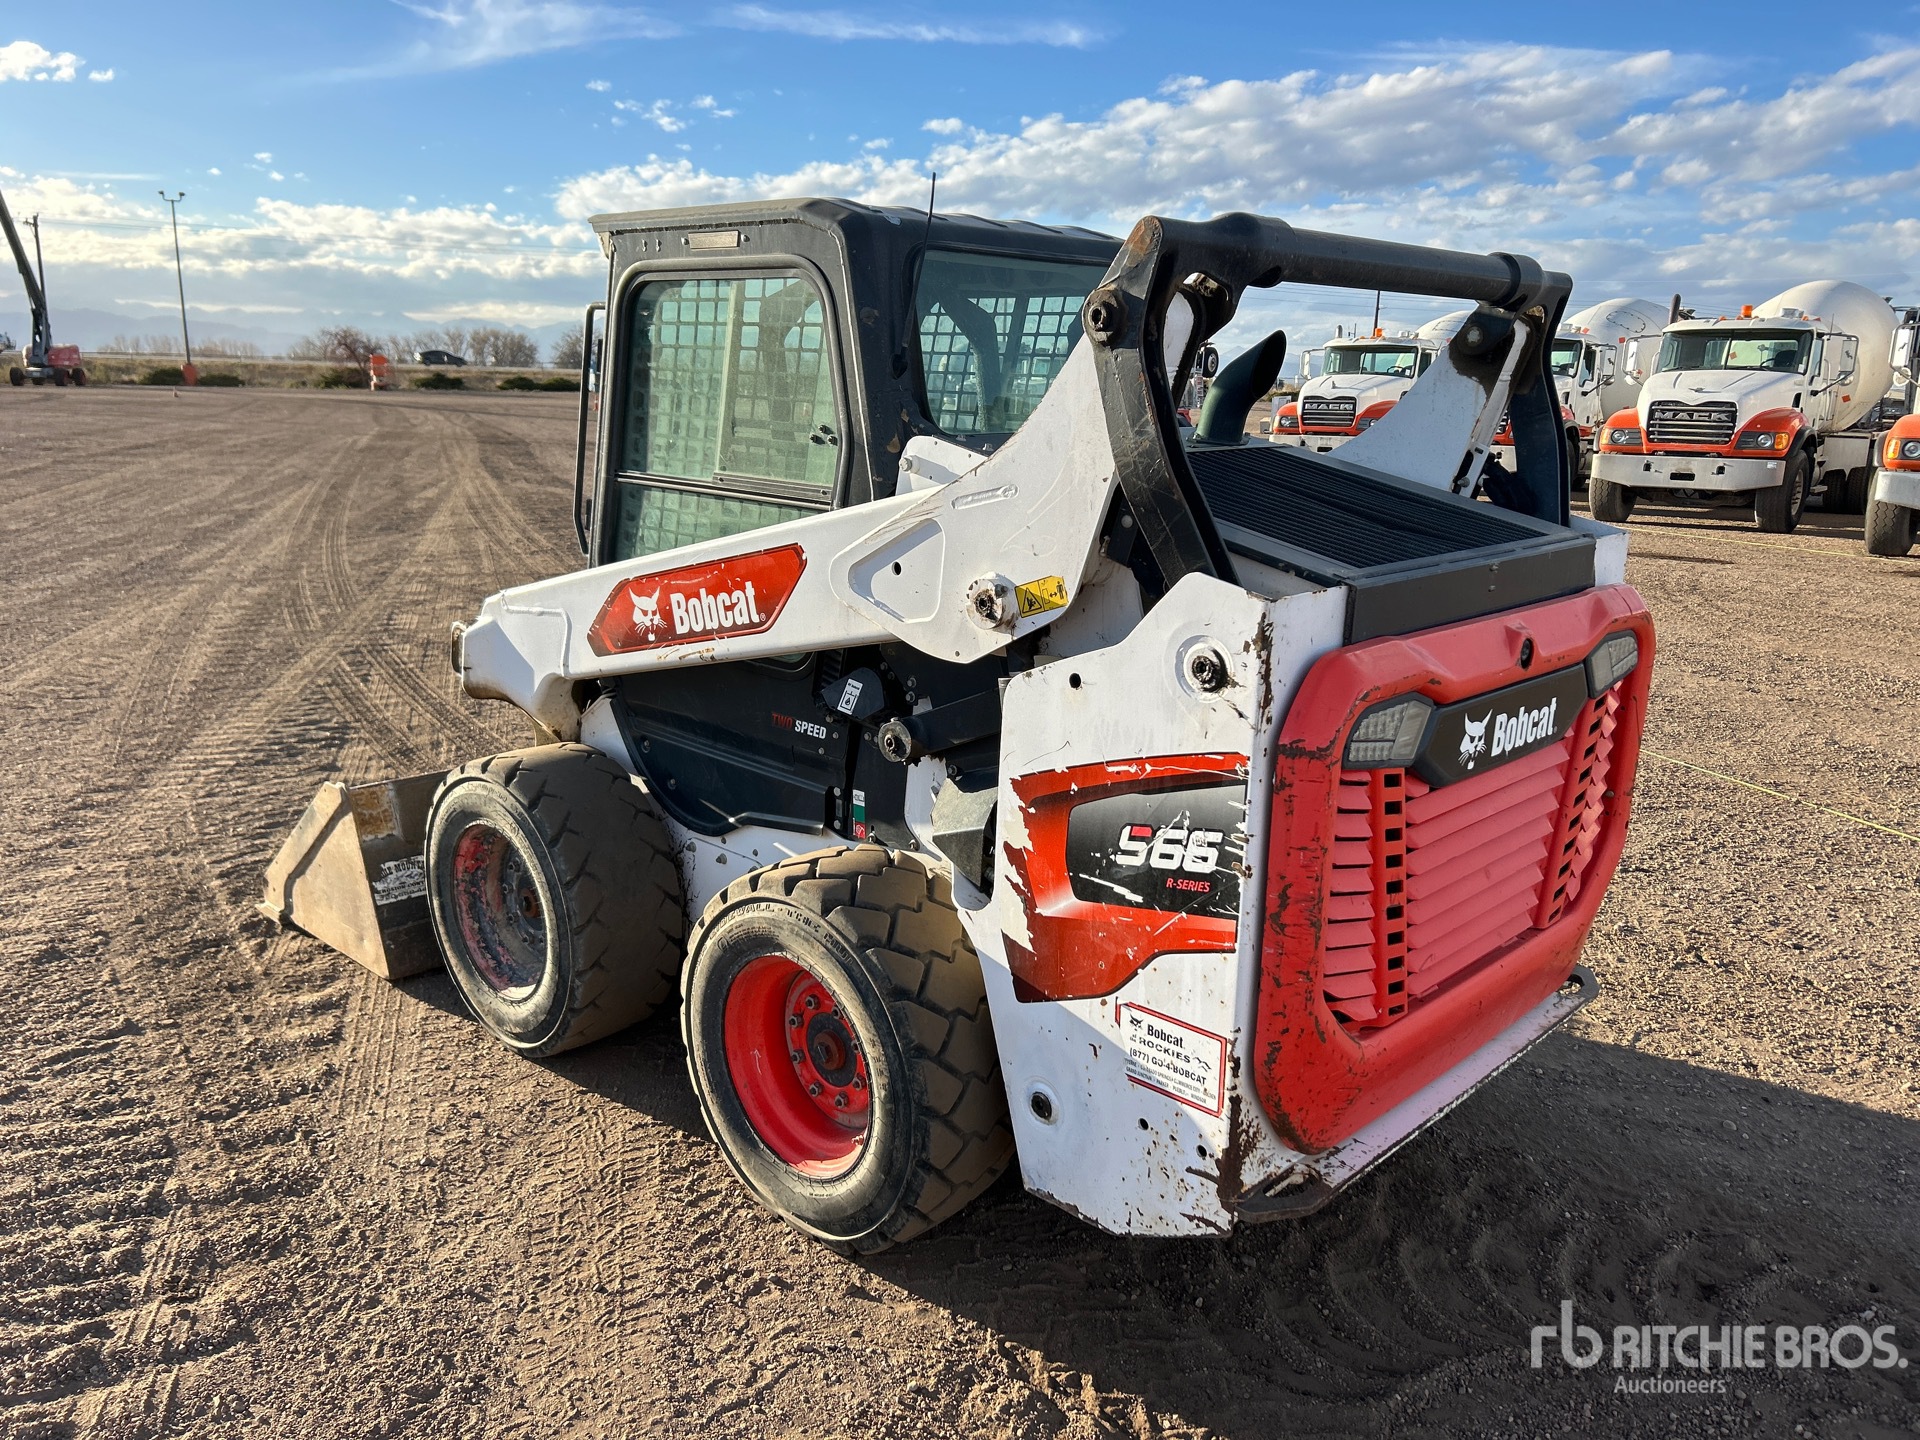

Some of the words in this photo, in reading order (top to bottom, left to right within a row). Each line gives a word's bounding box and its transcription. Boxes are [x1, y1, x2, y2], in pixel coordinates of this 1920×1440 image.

[1654, 411, 1731, 421] MACK
[670, 581, 760, 634] Bobcat
[772, 713, 793, 729] TWO
[794, 720, 827, 740] SPEED
[1490, 697, 1557, 757] Bobcat
[1115, 824, 1224, 874] S66
[1166, 877, 1211, 893] R-SERIES
[1139, 1036, 1191, 1063] ROCKIES
[1147, 1023, 1184, 1049] Bobcat
